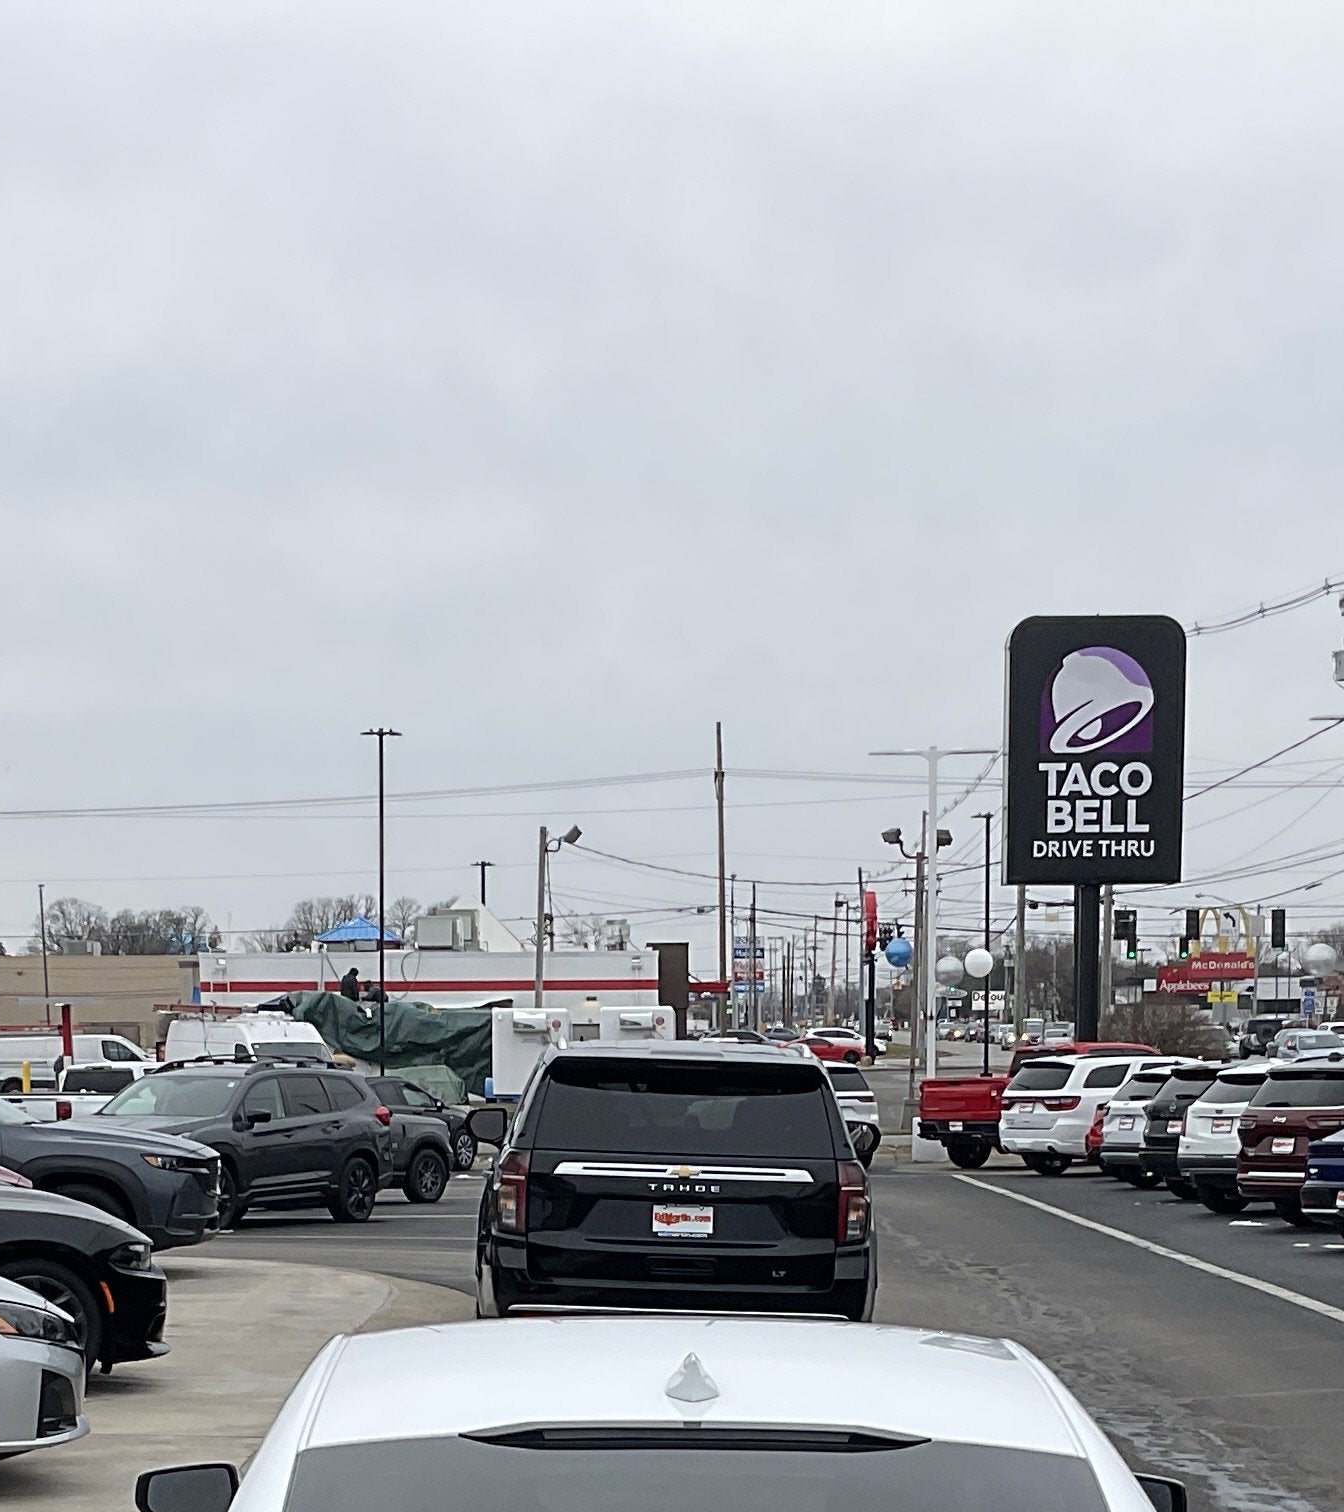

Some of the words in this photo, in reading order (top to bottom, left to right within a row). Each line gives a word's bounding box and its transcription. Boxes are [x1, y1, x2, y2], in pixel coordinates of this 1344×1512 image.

[1038, 761, 1153, 797] TACO
[1046, 799, 1150, 833] BELL
[1033, 840, 1094, 857] DRIVE
[1098, 839, 1155, 857] THRU
[1191, 960, 1255, 970] McDonald's
[647, 1183, 721, 1194] TAHOE
